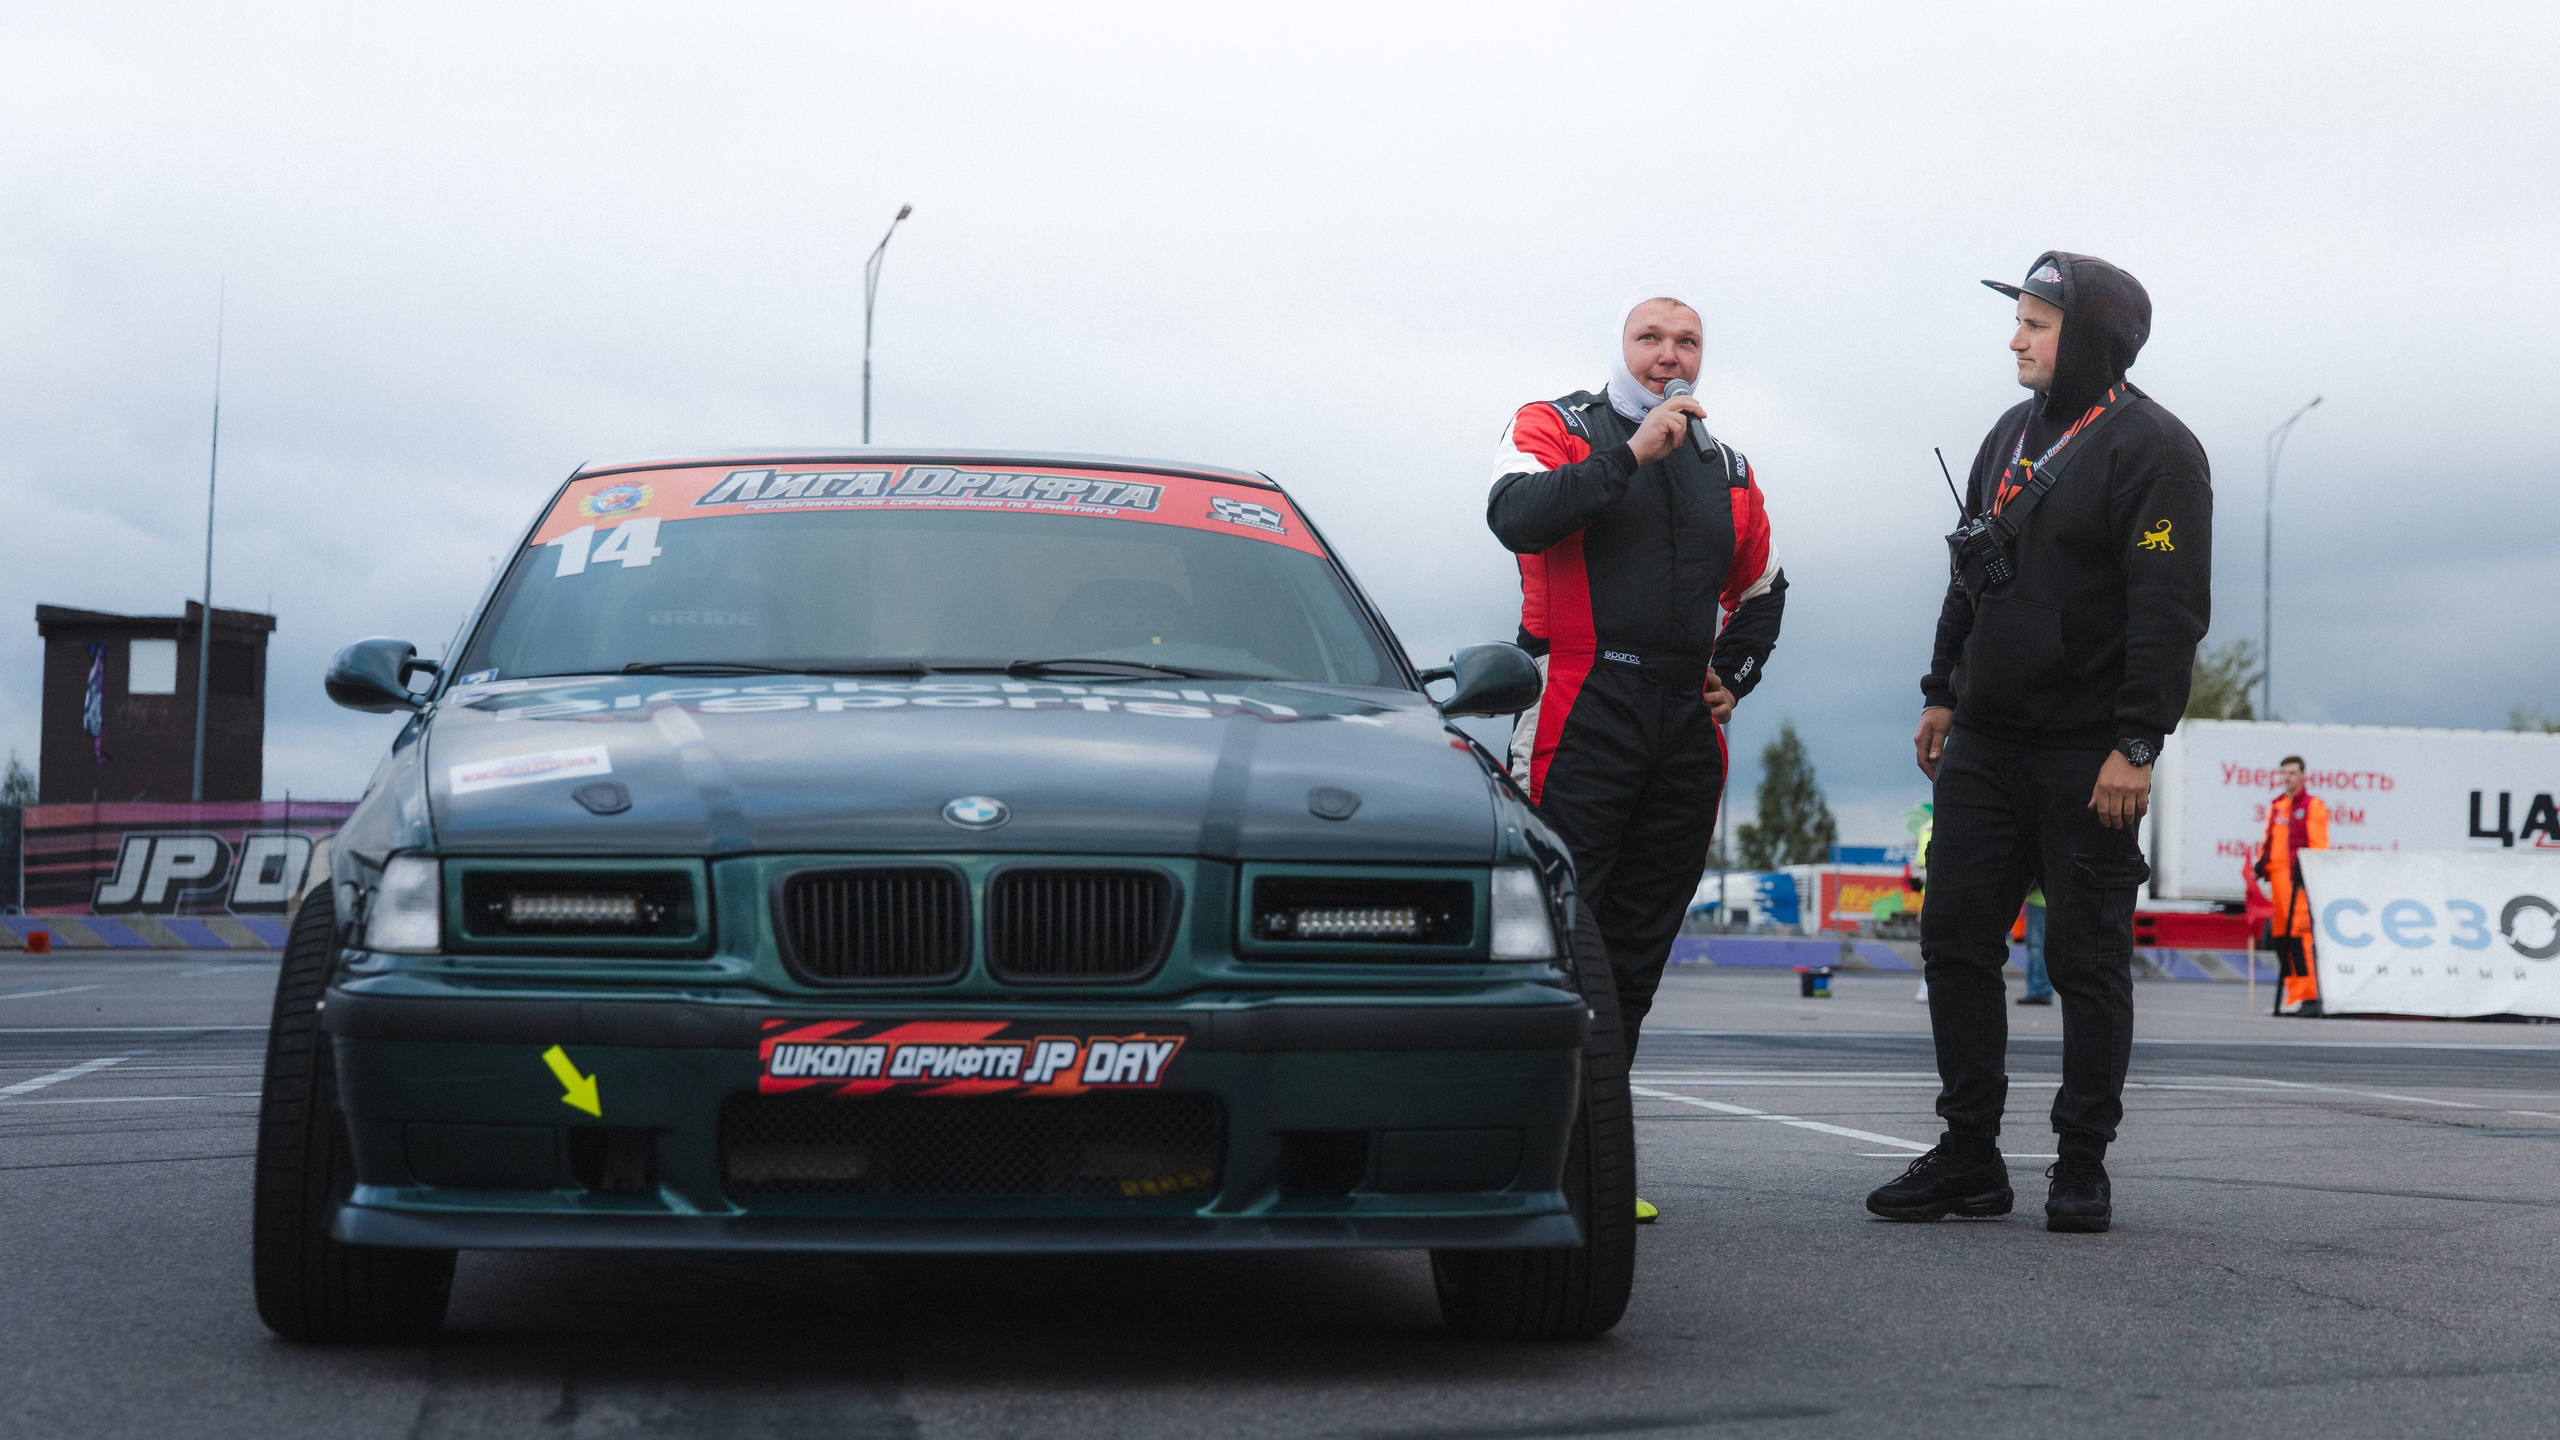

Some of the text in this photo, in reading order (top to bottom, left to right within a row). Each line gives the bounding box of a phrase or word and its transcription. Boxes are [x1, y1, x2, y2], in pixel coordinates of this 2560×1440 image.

[1006, 501, 1029, 509] ПО
[546, 517, 662, 578] 14
[2221, 762, 2395, 791] Увернность
[98, 838, 219, 903] JP
[770, 1041, 1175, 1084] ШКОЛА ДРИФТА JP DAY
